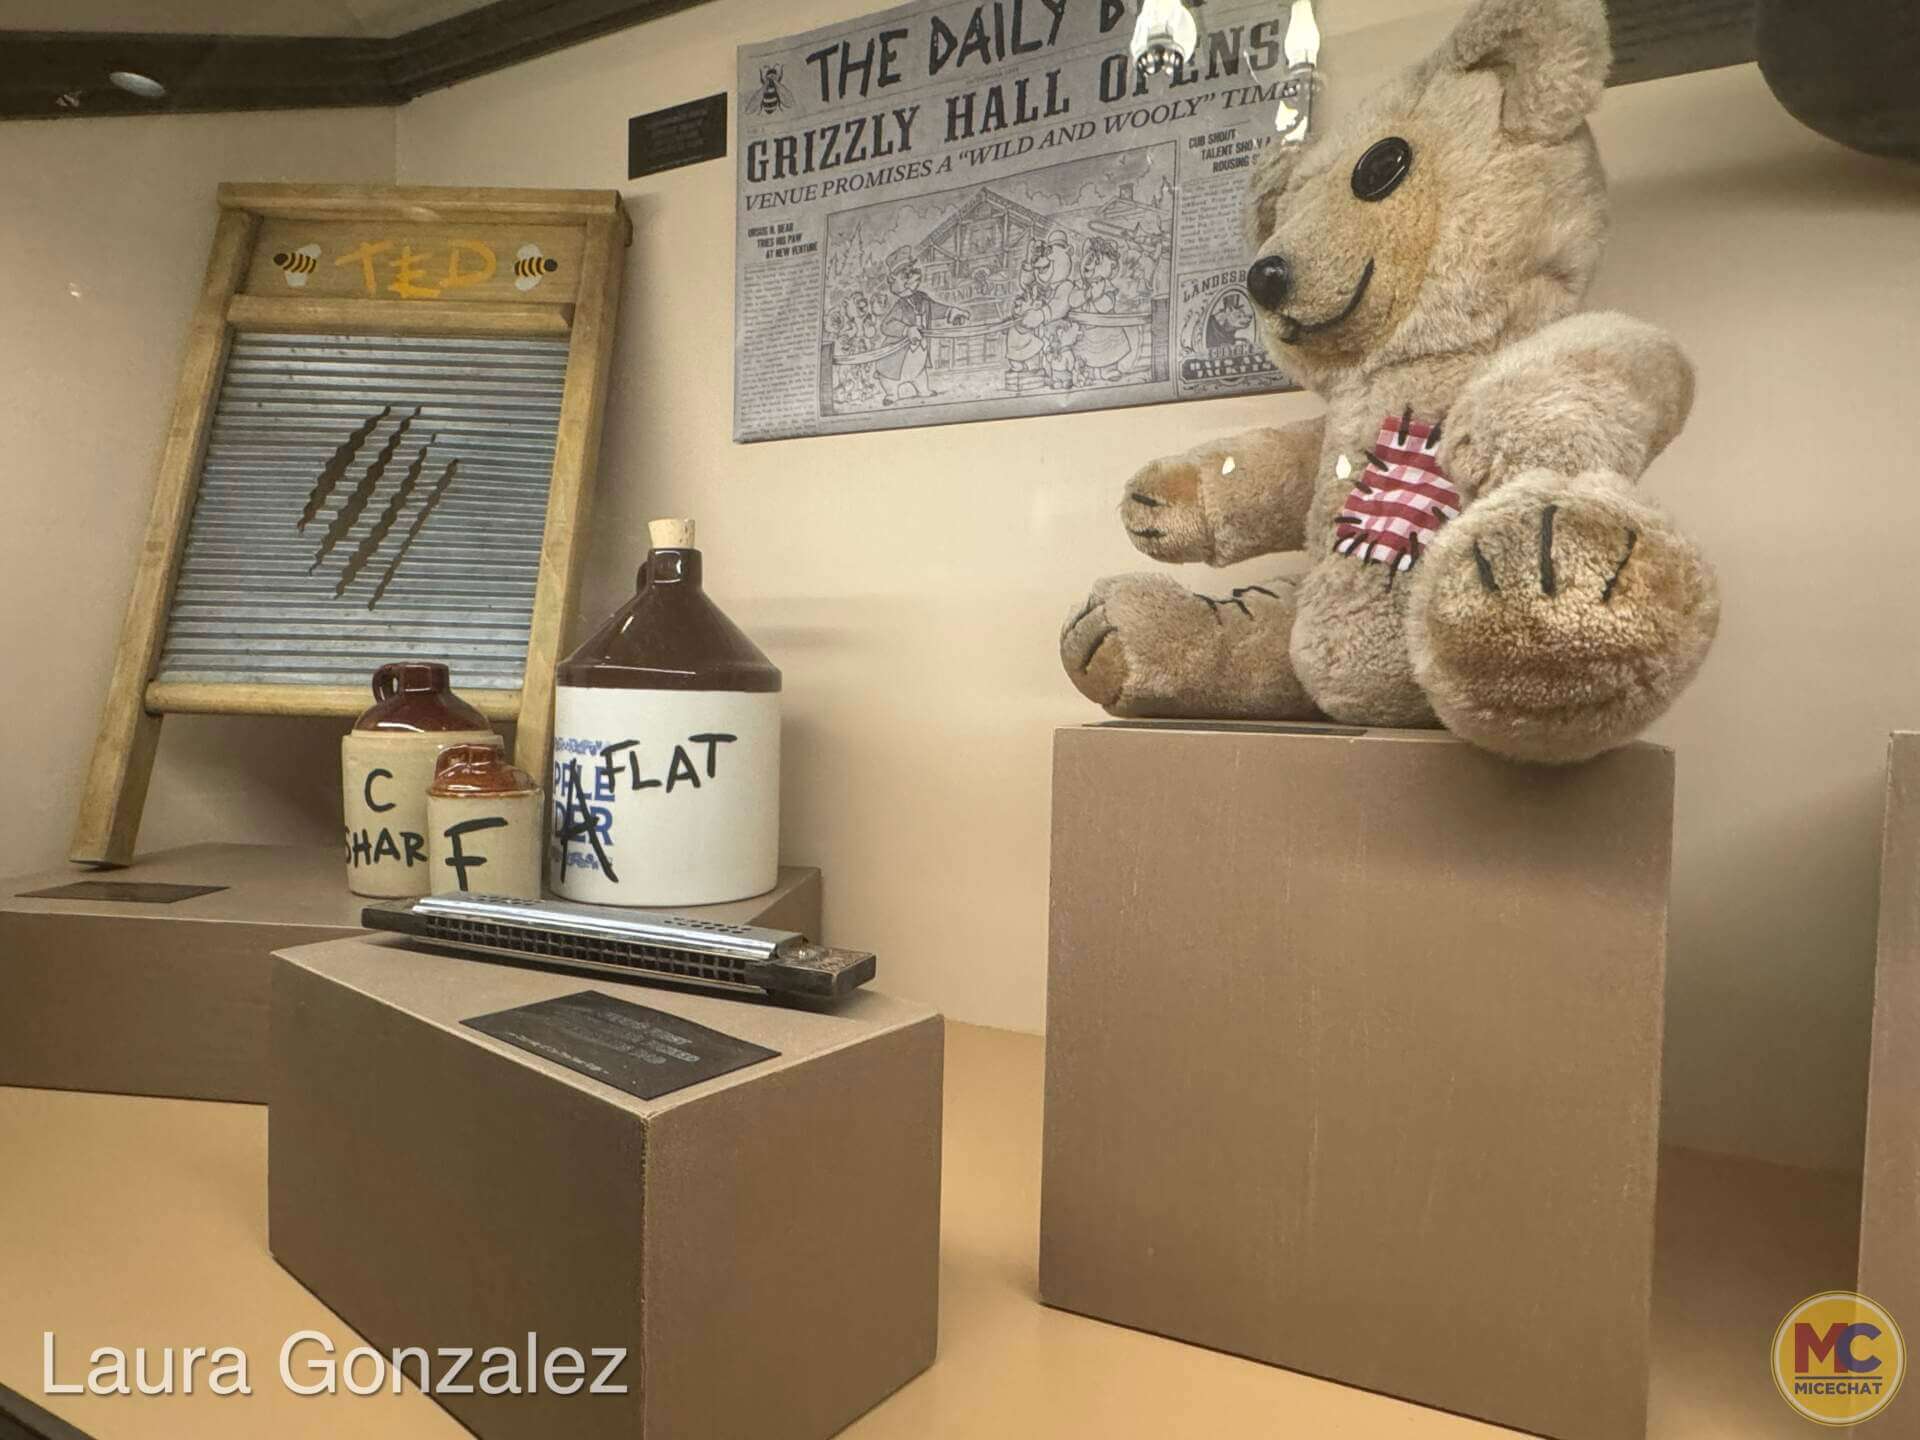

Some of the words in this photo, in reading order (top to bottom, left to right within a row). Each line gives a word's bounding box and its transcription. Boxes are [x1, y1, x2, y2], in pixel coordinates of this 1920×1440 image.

[805, 28, 909, 103] THE
[929, 0, 1067, 76] DAILY
[747, 104, 920, 183] GRIZZLY
[944, 68, 1070, 143] HALL
[1189, 136, 1206, 149] CUB
[745, 184, 818, 211] VENUE
[820, 158, 933, 199] PROMISES
[935, 155, 953, 174] A
[1038, 120, 1097, 151] AND
[1201, 145, 1233, 160] TALENT
[1213, 157, 1248, 172] ROUSING
[775, 246, 791, 258] NEW
[787, 233, 802, 245] PAW
[334, 240, 497, 298] TED
[599, 733, 738, 794] FLAT
[365, 768, 396, 813] C
[444, 817, 509, 893] F
